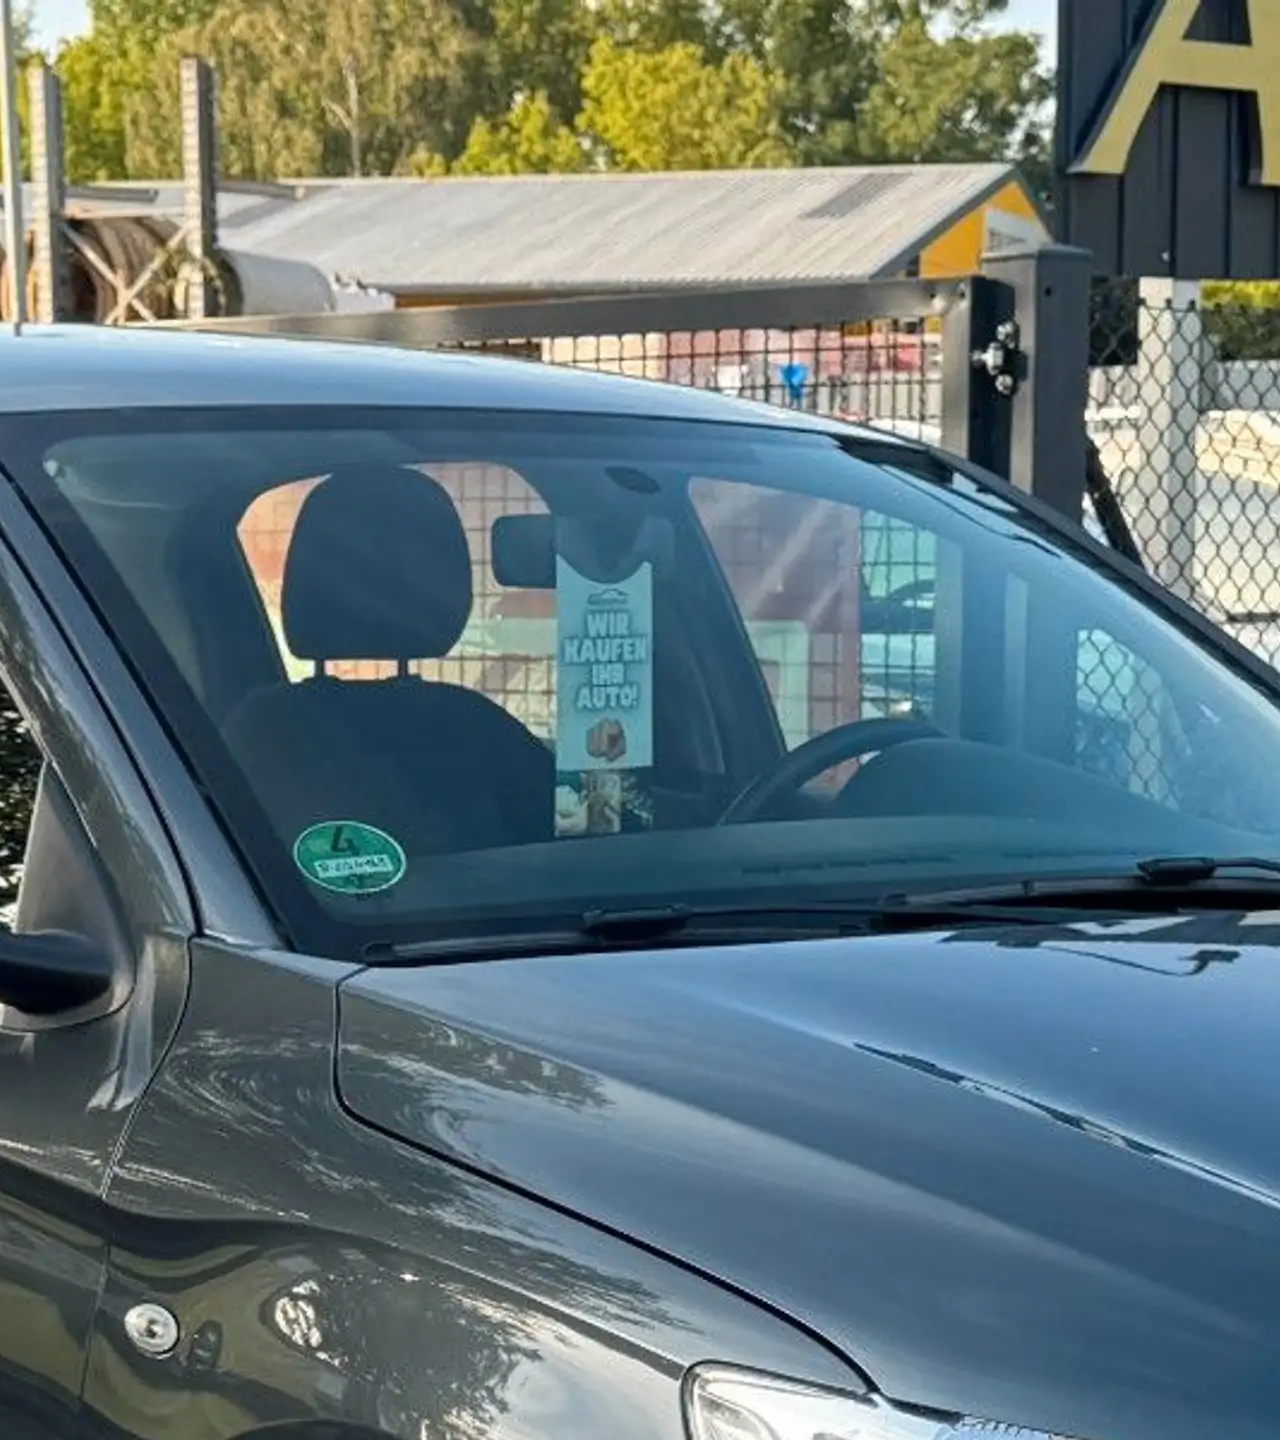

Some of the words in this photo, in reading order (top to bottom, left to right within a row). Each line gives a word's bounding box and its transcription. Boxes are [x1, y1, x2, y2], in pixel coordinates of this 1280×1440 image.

[586, 611, 629, 638] WIR
[564, 637, 647, 663] KAUFEN
[592, 664, 624, 685] IHR
[576, 686, 638, 709] AUTO!
